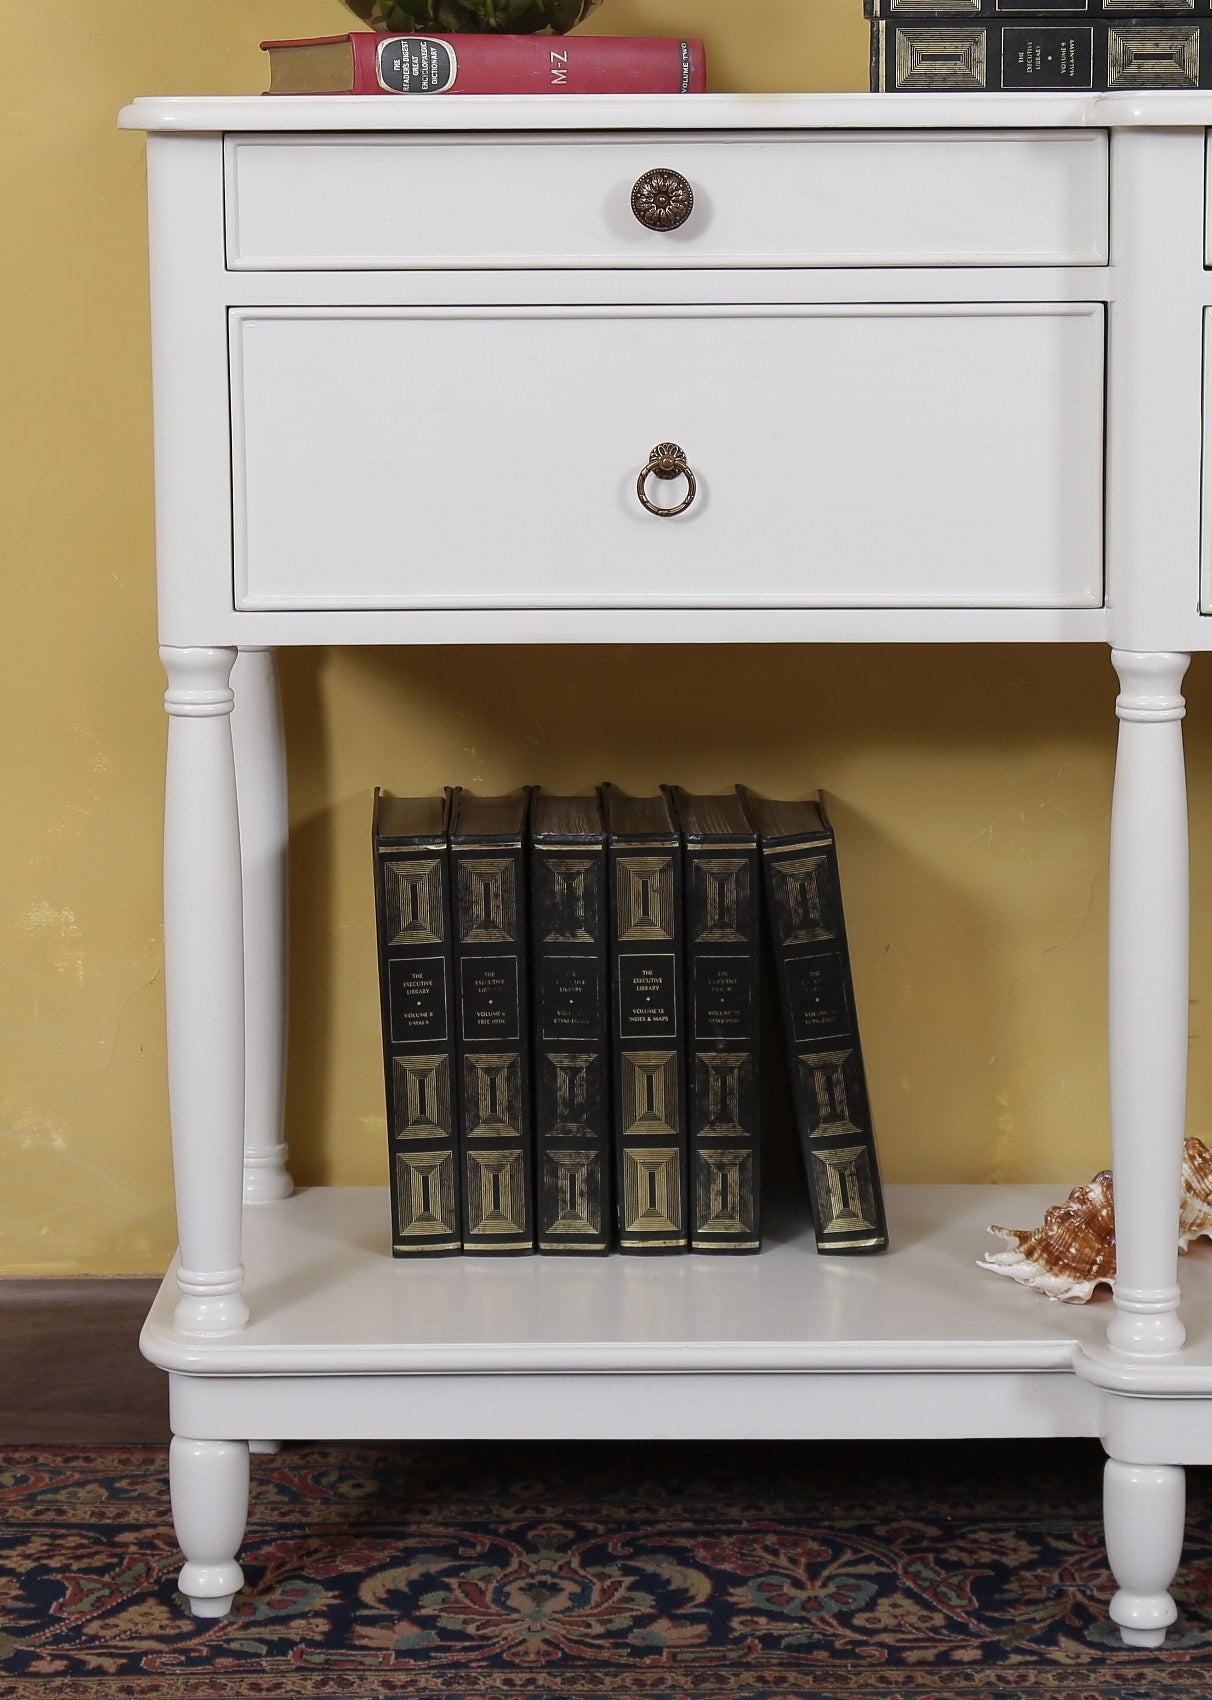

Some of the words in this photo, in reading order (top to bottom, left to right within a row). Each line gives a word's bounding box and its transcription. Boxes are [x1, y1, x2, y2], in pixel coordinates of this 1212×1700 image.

[401, 41, 409, 62] DIGEST
[402, 63, 410, 91] READER'S
[421, 42, 429, 90] ENCYCLOPAEDIC
[551, 50, 567, 84] M-Z
[403, 980, 432, 988] EXECUTIVE
[404, 1011, 427, 1019] VOLUME
